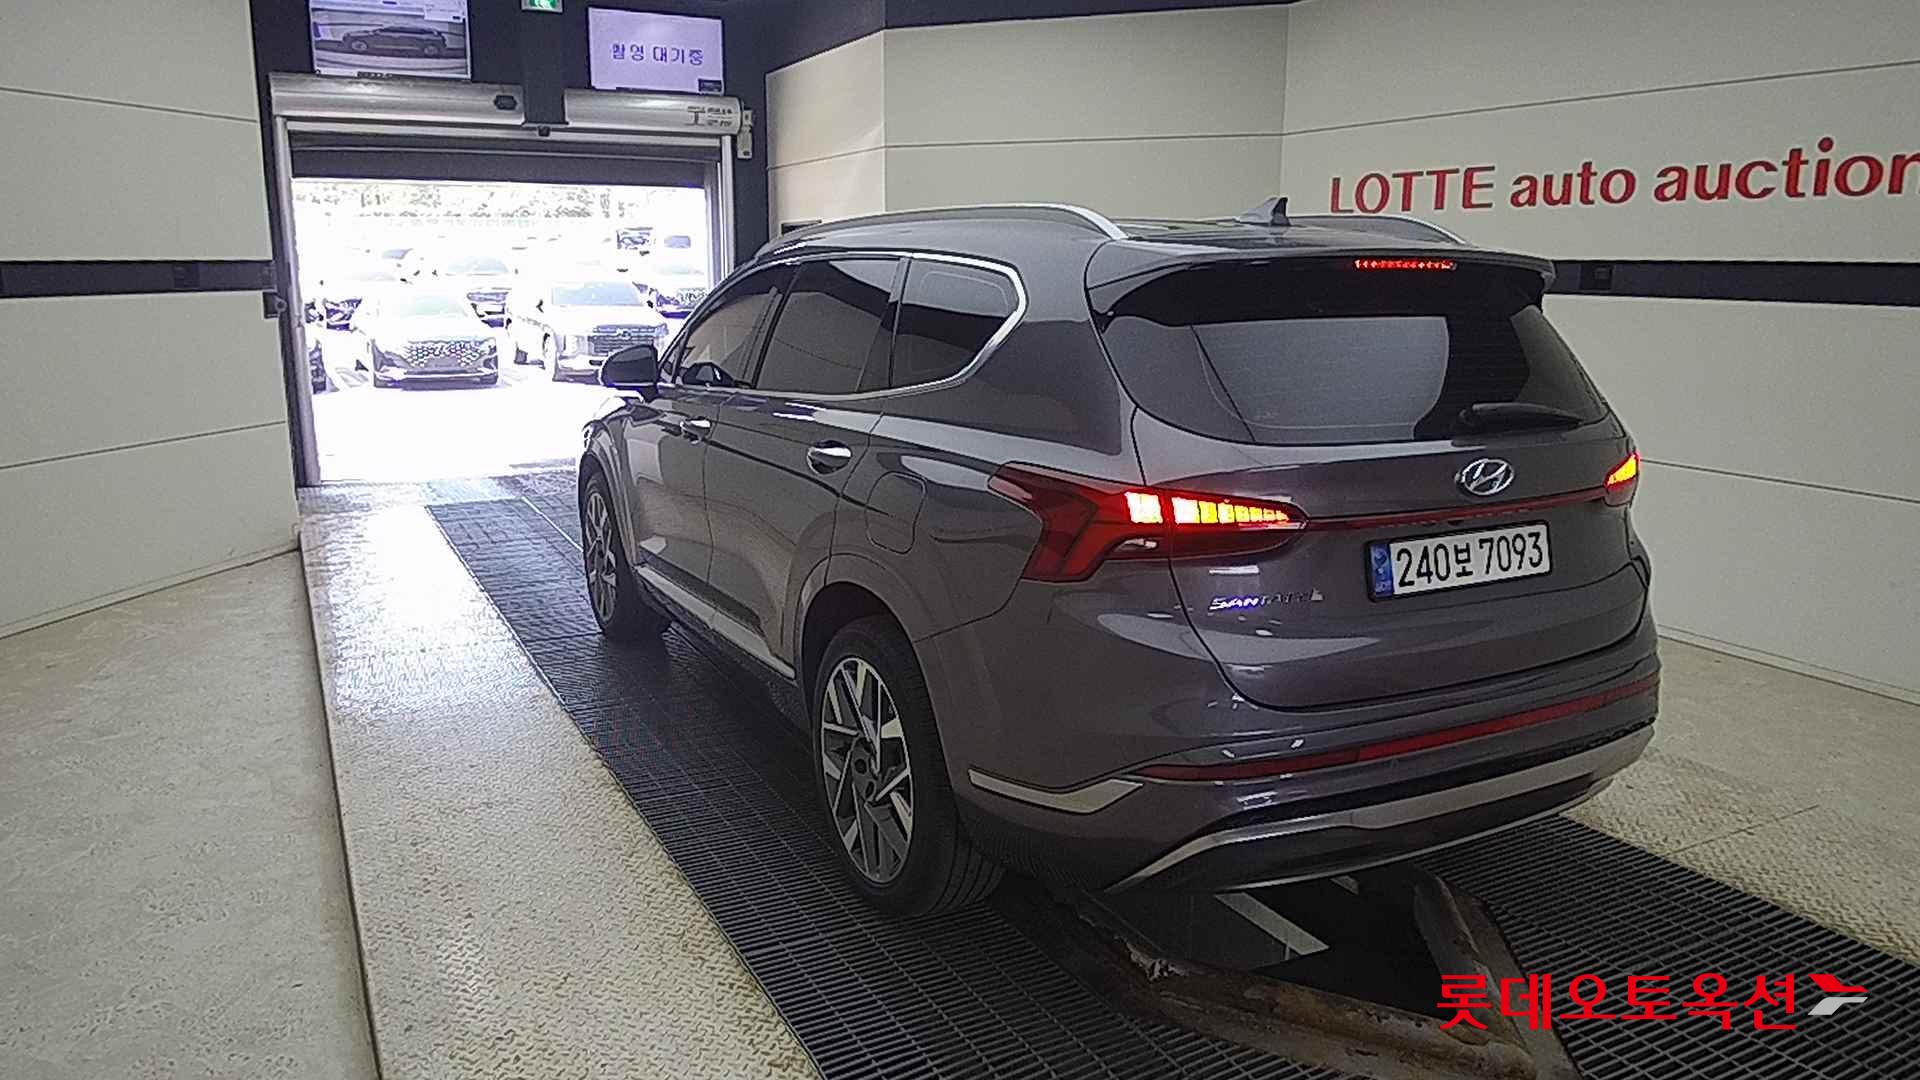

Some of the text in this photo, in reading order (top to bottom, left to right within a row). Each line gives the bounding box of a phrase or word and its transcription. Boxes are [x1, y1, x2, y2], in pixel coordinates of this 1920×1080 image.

[1331, 166, 1496, 214] LOTTE
[1510, 161, 1637, 209] auto
[1396, 532, 1543, 588] 240보 7093
